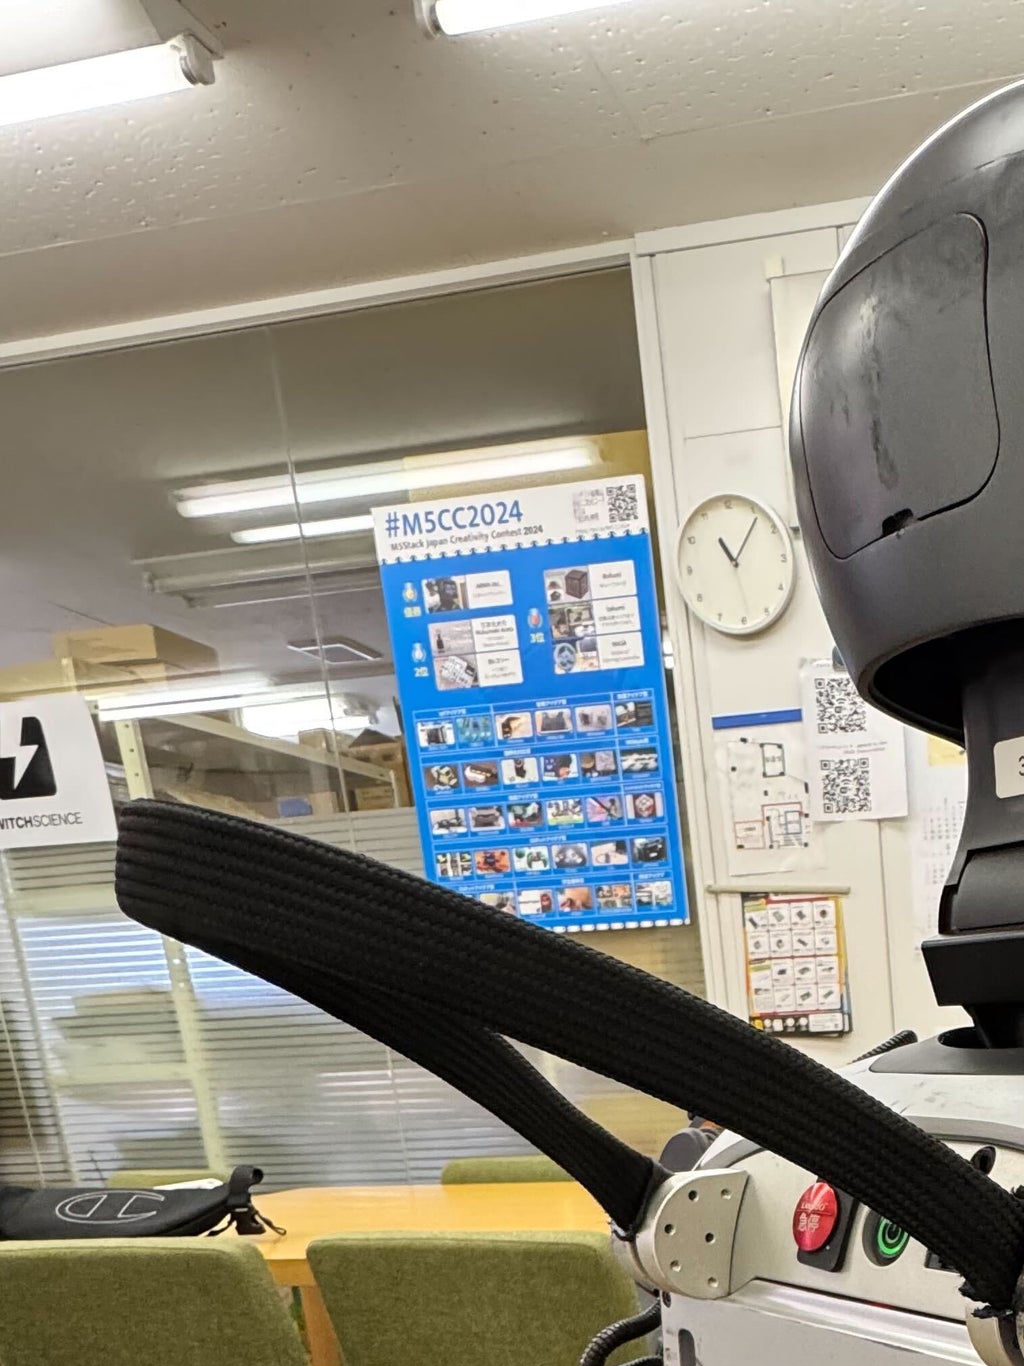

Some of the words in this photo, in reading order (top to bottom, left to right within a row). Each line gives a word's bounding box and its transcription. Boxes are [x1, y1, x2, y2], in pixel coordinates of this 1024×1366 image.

[386, 500, 523, 537] #M5CC2024
[450, 532, 489, 543] Creativity
[491, 529, 521, 539] Contest
[523, 525, 543, 535] 2024
